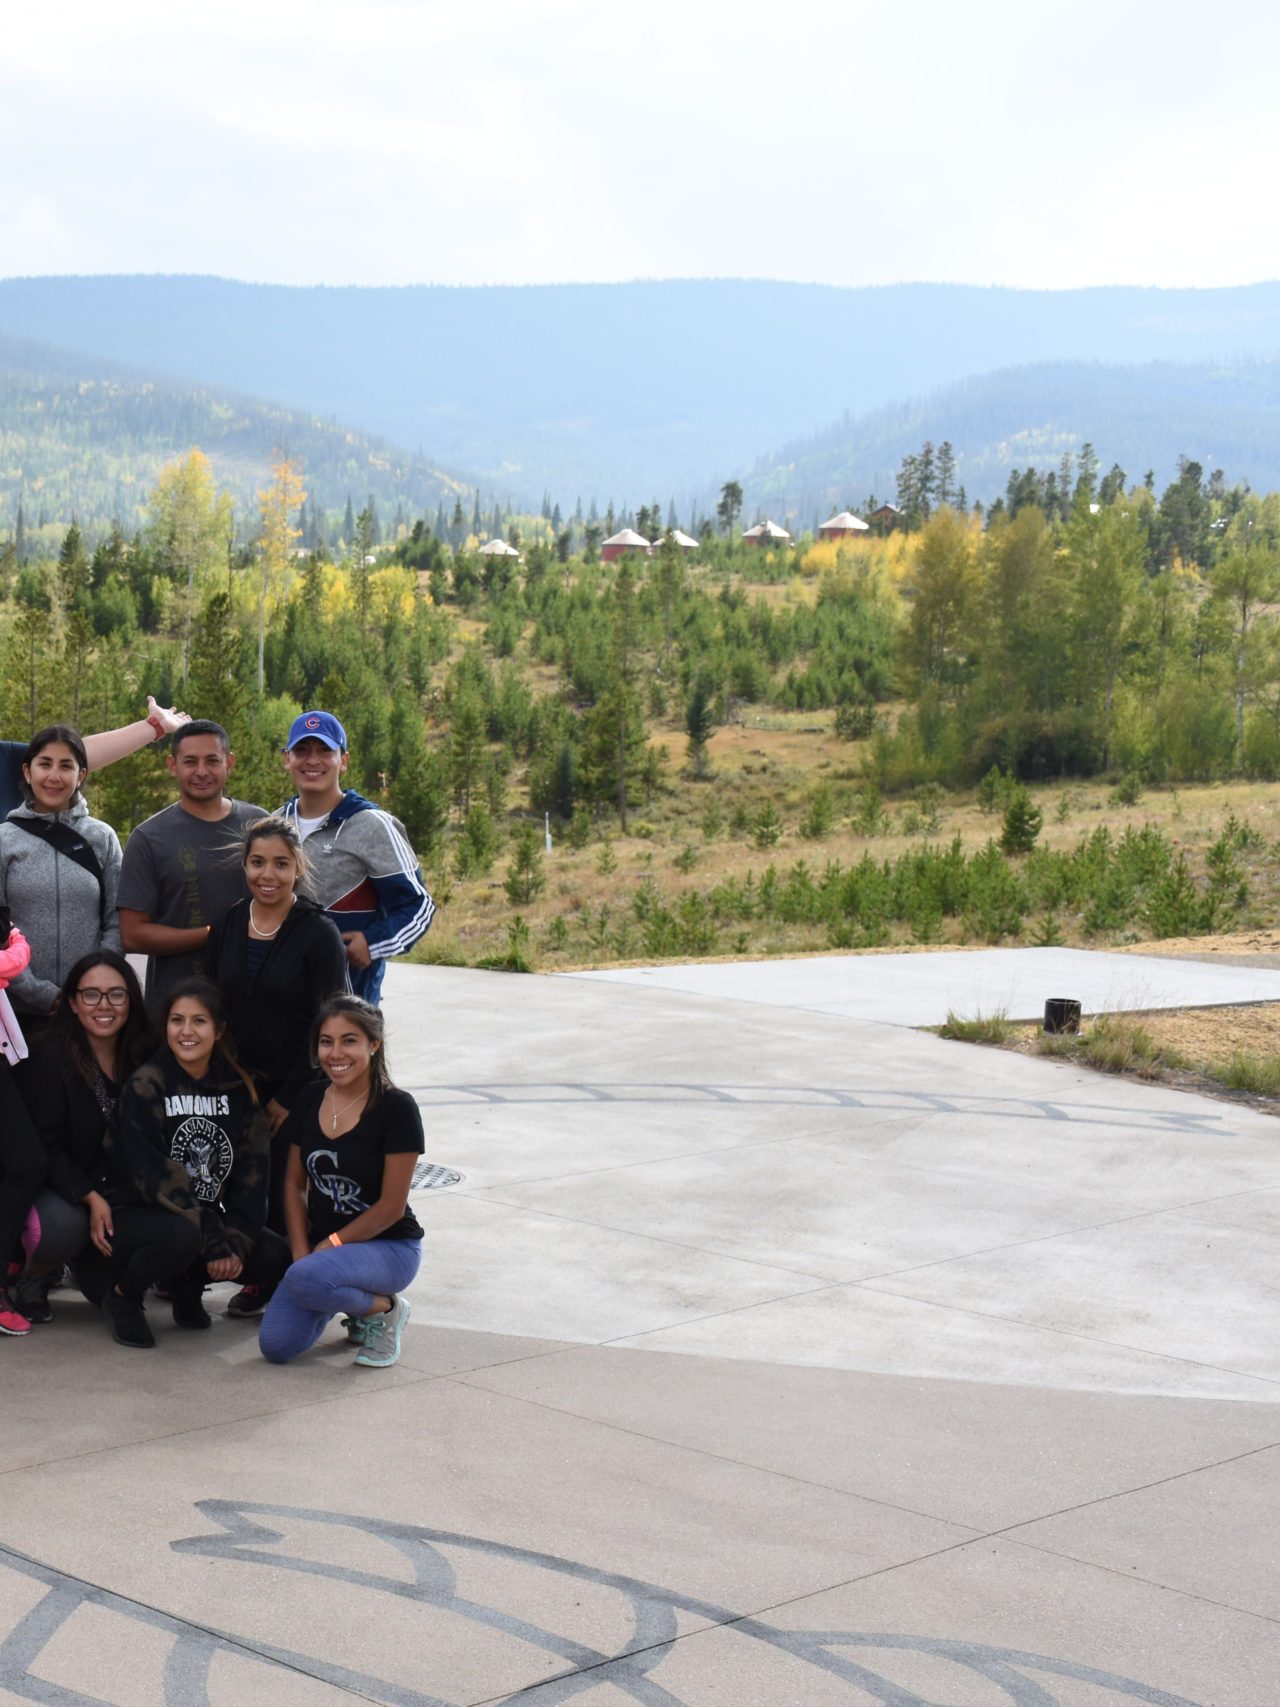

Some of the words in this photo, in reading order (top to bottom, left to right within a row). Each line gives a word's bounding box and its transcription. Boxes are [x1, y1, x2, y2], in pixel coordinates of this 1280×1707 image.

[305, 717, 320, 729] C
[164, 1095, 230, 1117] RAMONES
[219, 1140, 231, 1171] JOEY
